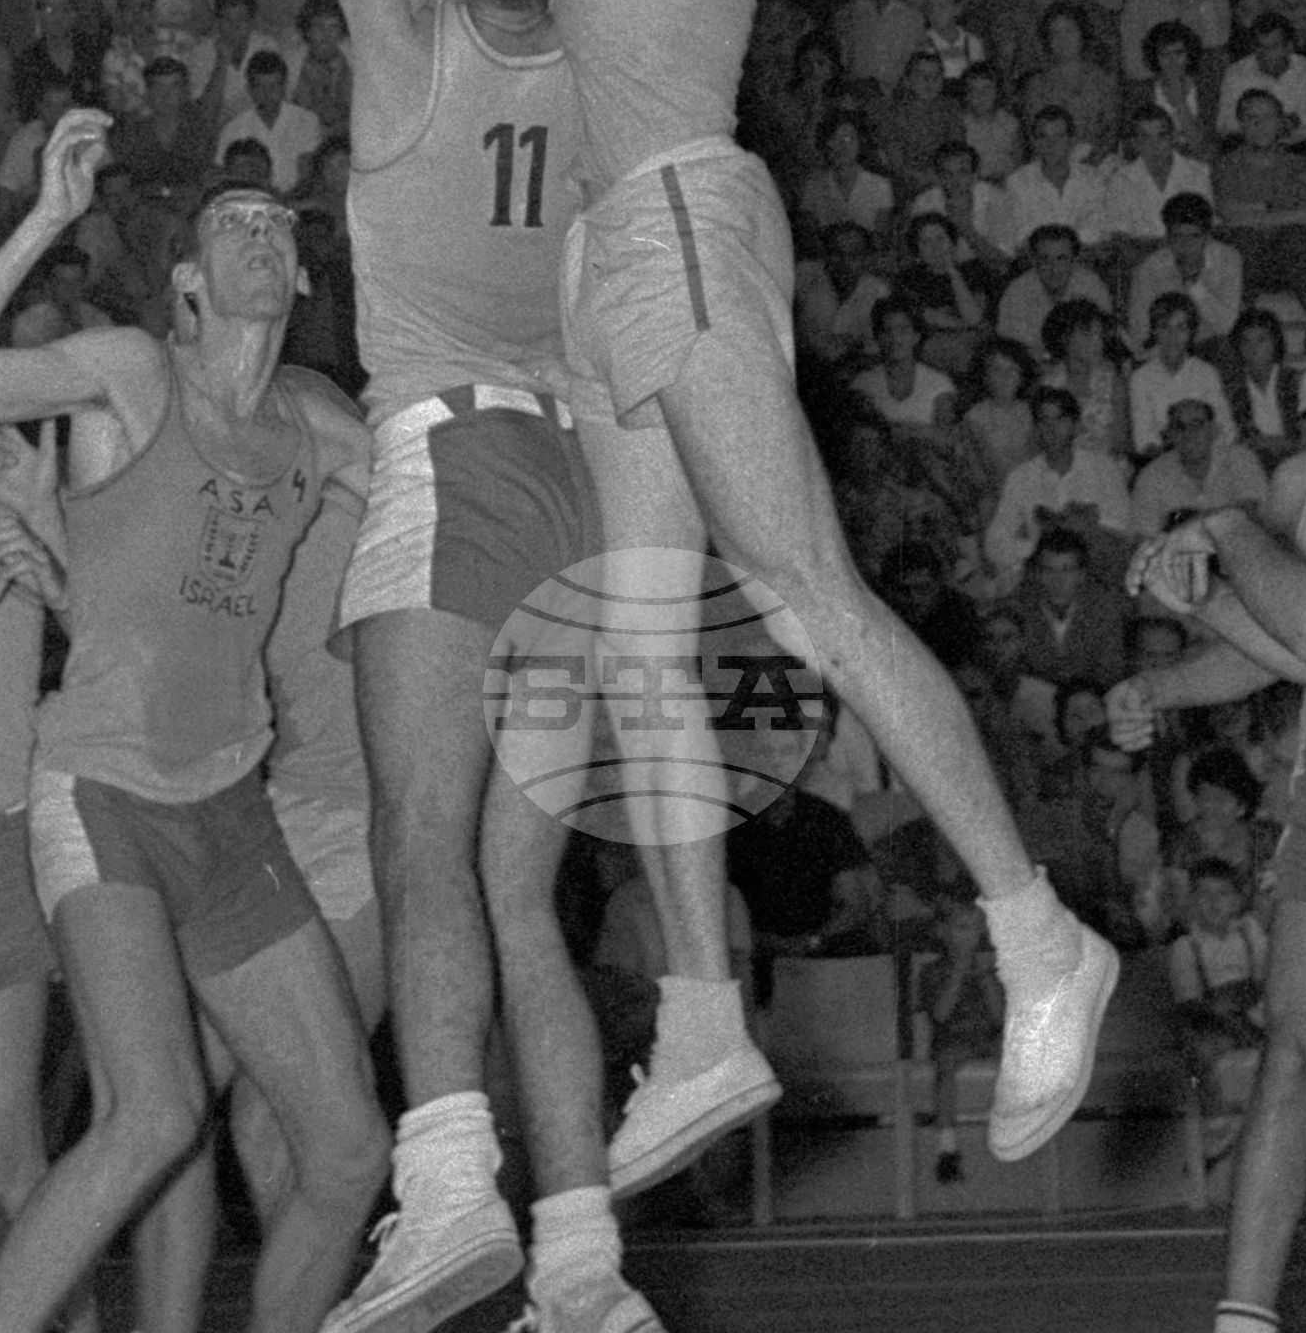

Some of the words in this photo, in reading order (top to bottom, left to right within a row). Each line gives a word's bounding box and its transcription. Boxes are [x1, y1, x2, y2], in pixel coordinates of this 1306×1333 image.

[483, 123, 548, 228] 11
[293, 468, 307, 503] 4
[179, 575, 257, 617] ISRAEL
